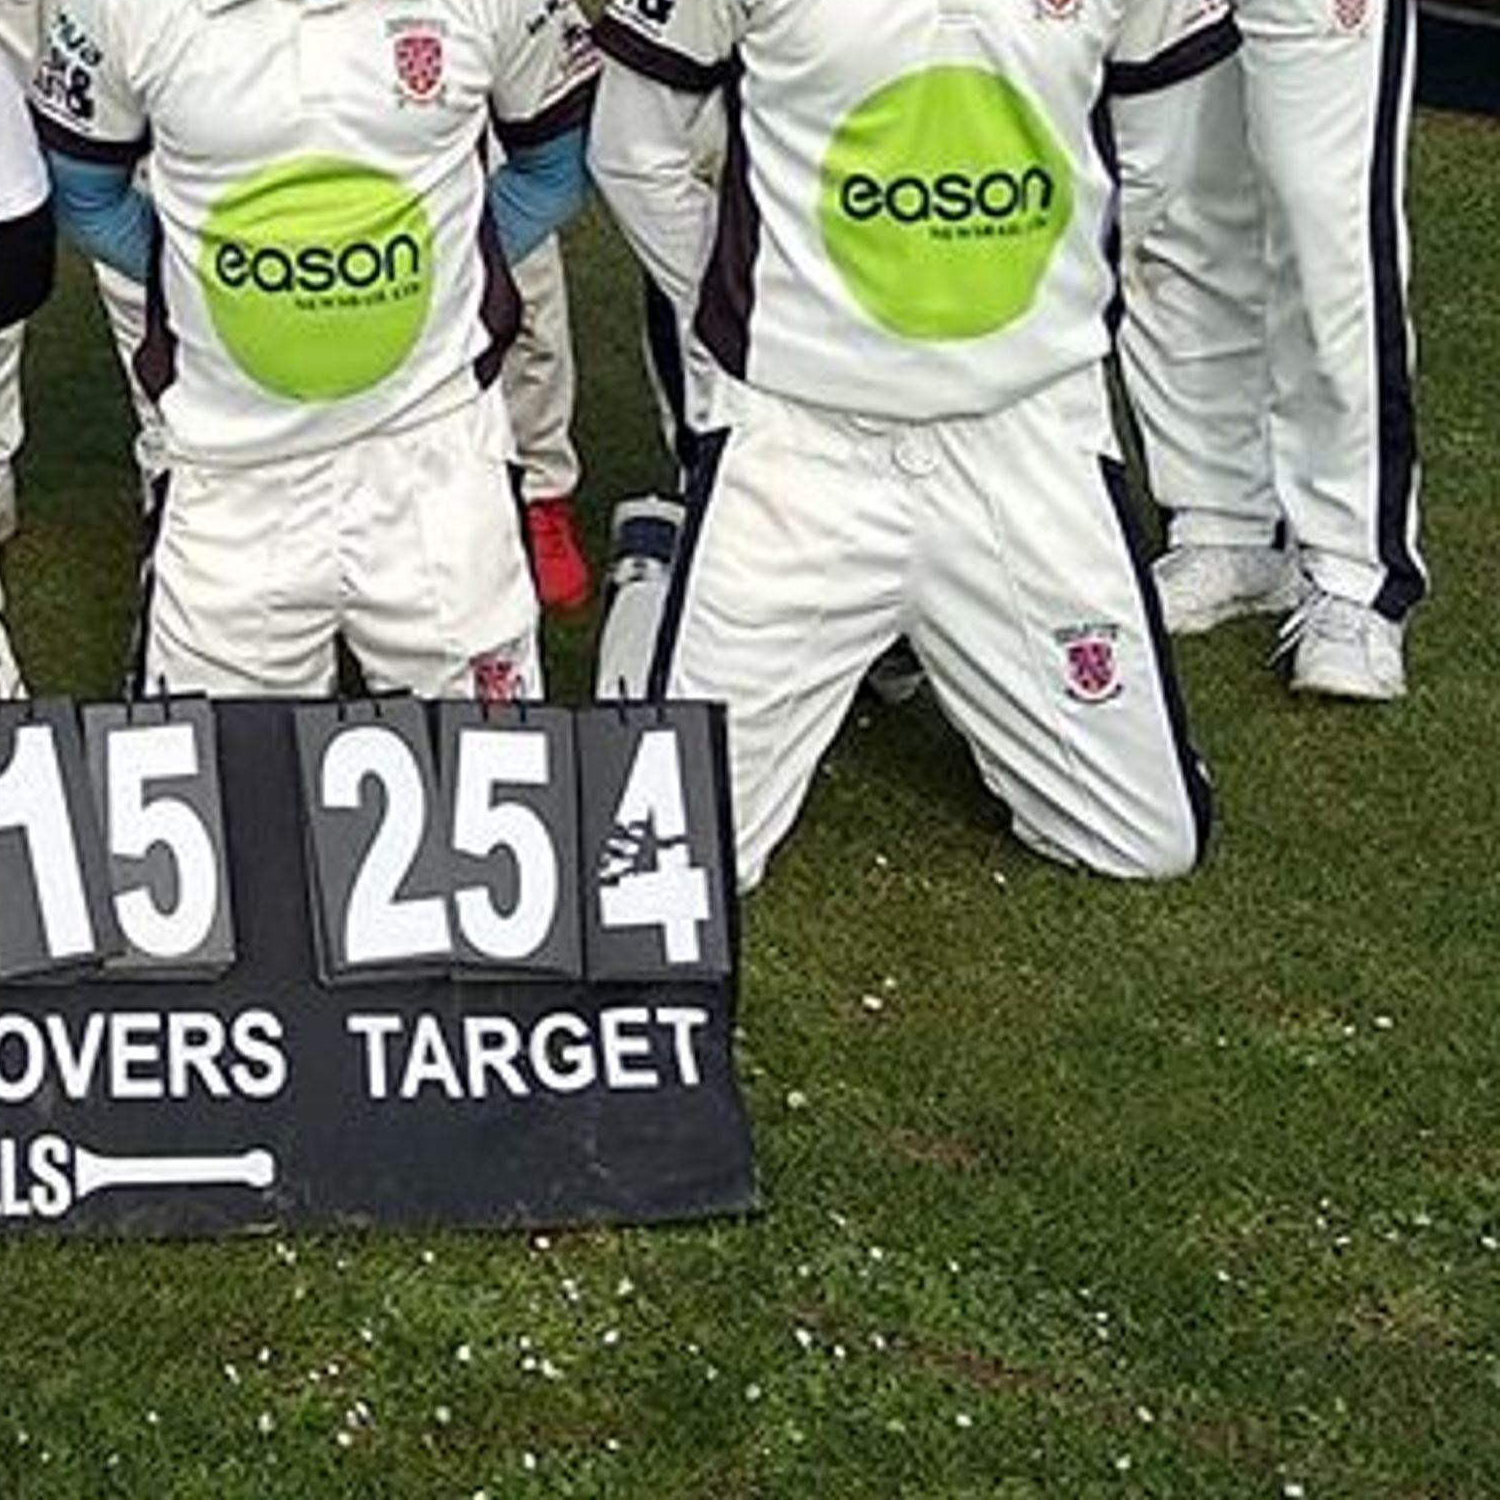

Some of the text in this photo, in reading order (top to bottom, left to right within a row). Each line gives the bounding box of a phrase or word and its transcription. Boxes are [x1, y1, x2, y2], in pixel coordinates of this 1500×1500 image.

[841, 166, 1055, 223] eason
[215, 233, 420, 293] eason
[347, 1007, 708, 1099] TARGET
